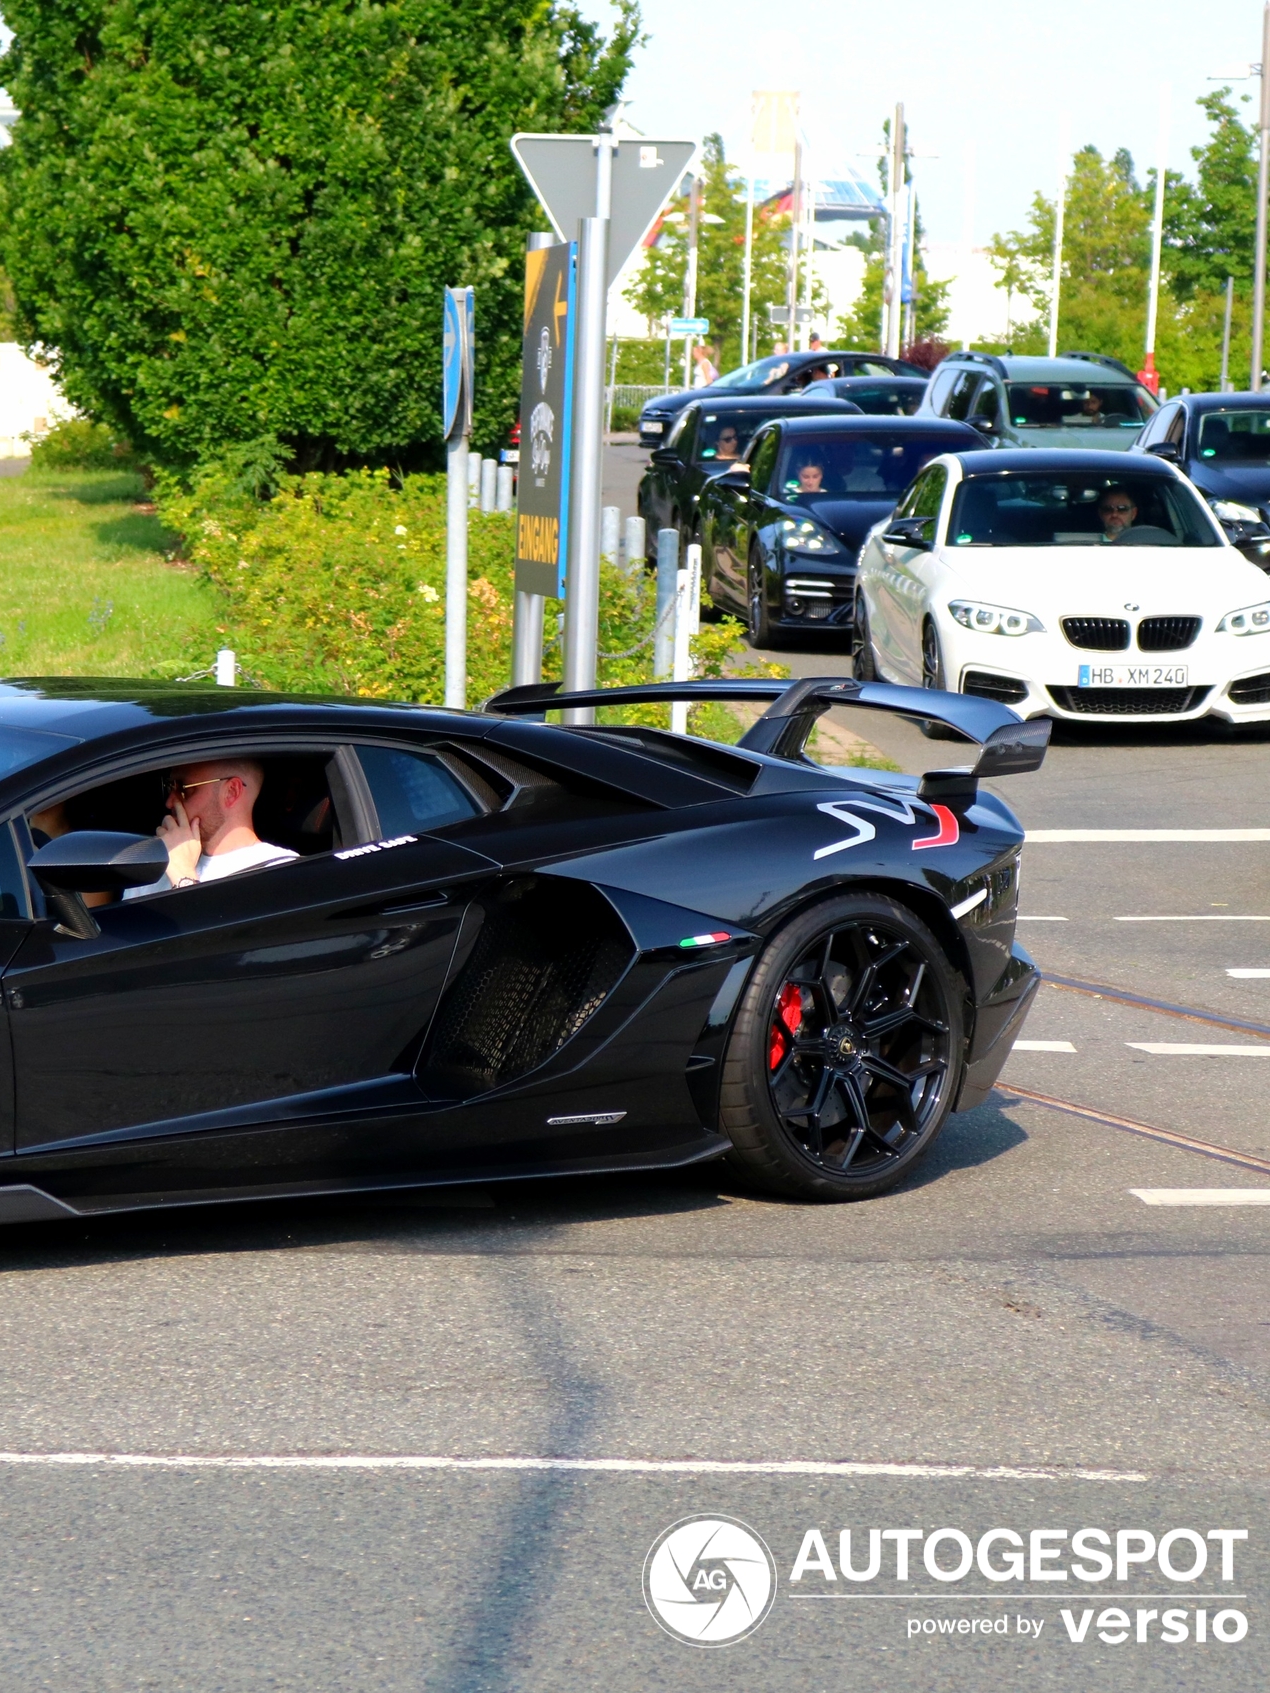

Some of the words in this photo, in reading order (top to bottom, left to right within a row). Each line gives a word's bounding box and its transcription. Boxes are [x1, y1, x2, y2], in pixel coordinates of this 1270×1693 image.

[518, 514, 559, 565] EINGANG
[1091, 668, 1114, 684] HB
[1127, 668, 1150, 684] XM
[1153, 668, 1185, 684] 240
